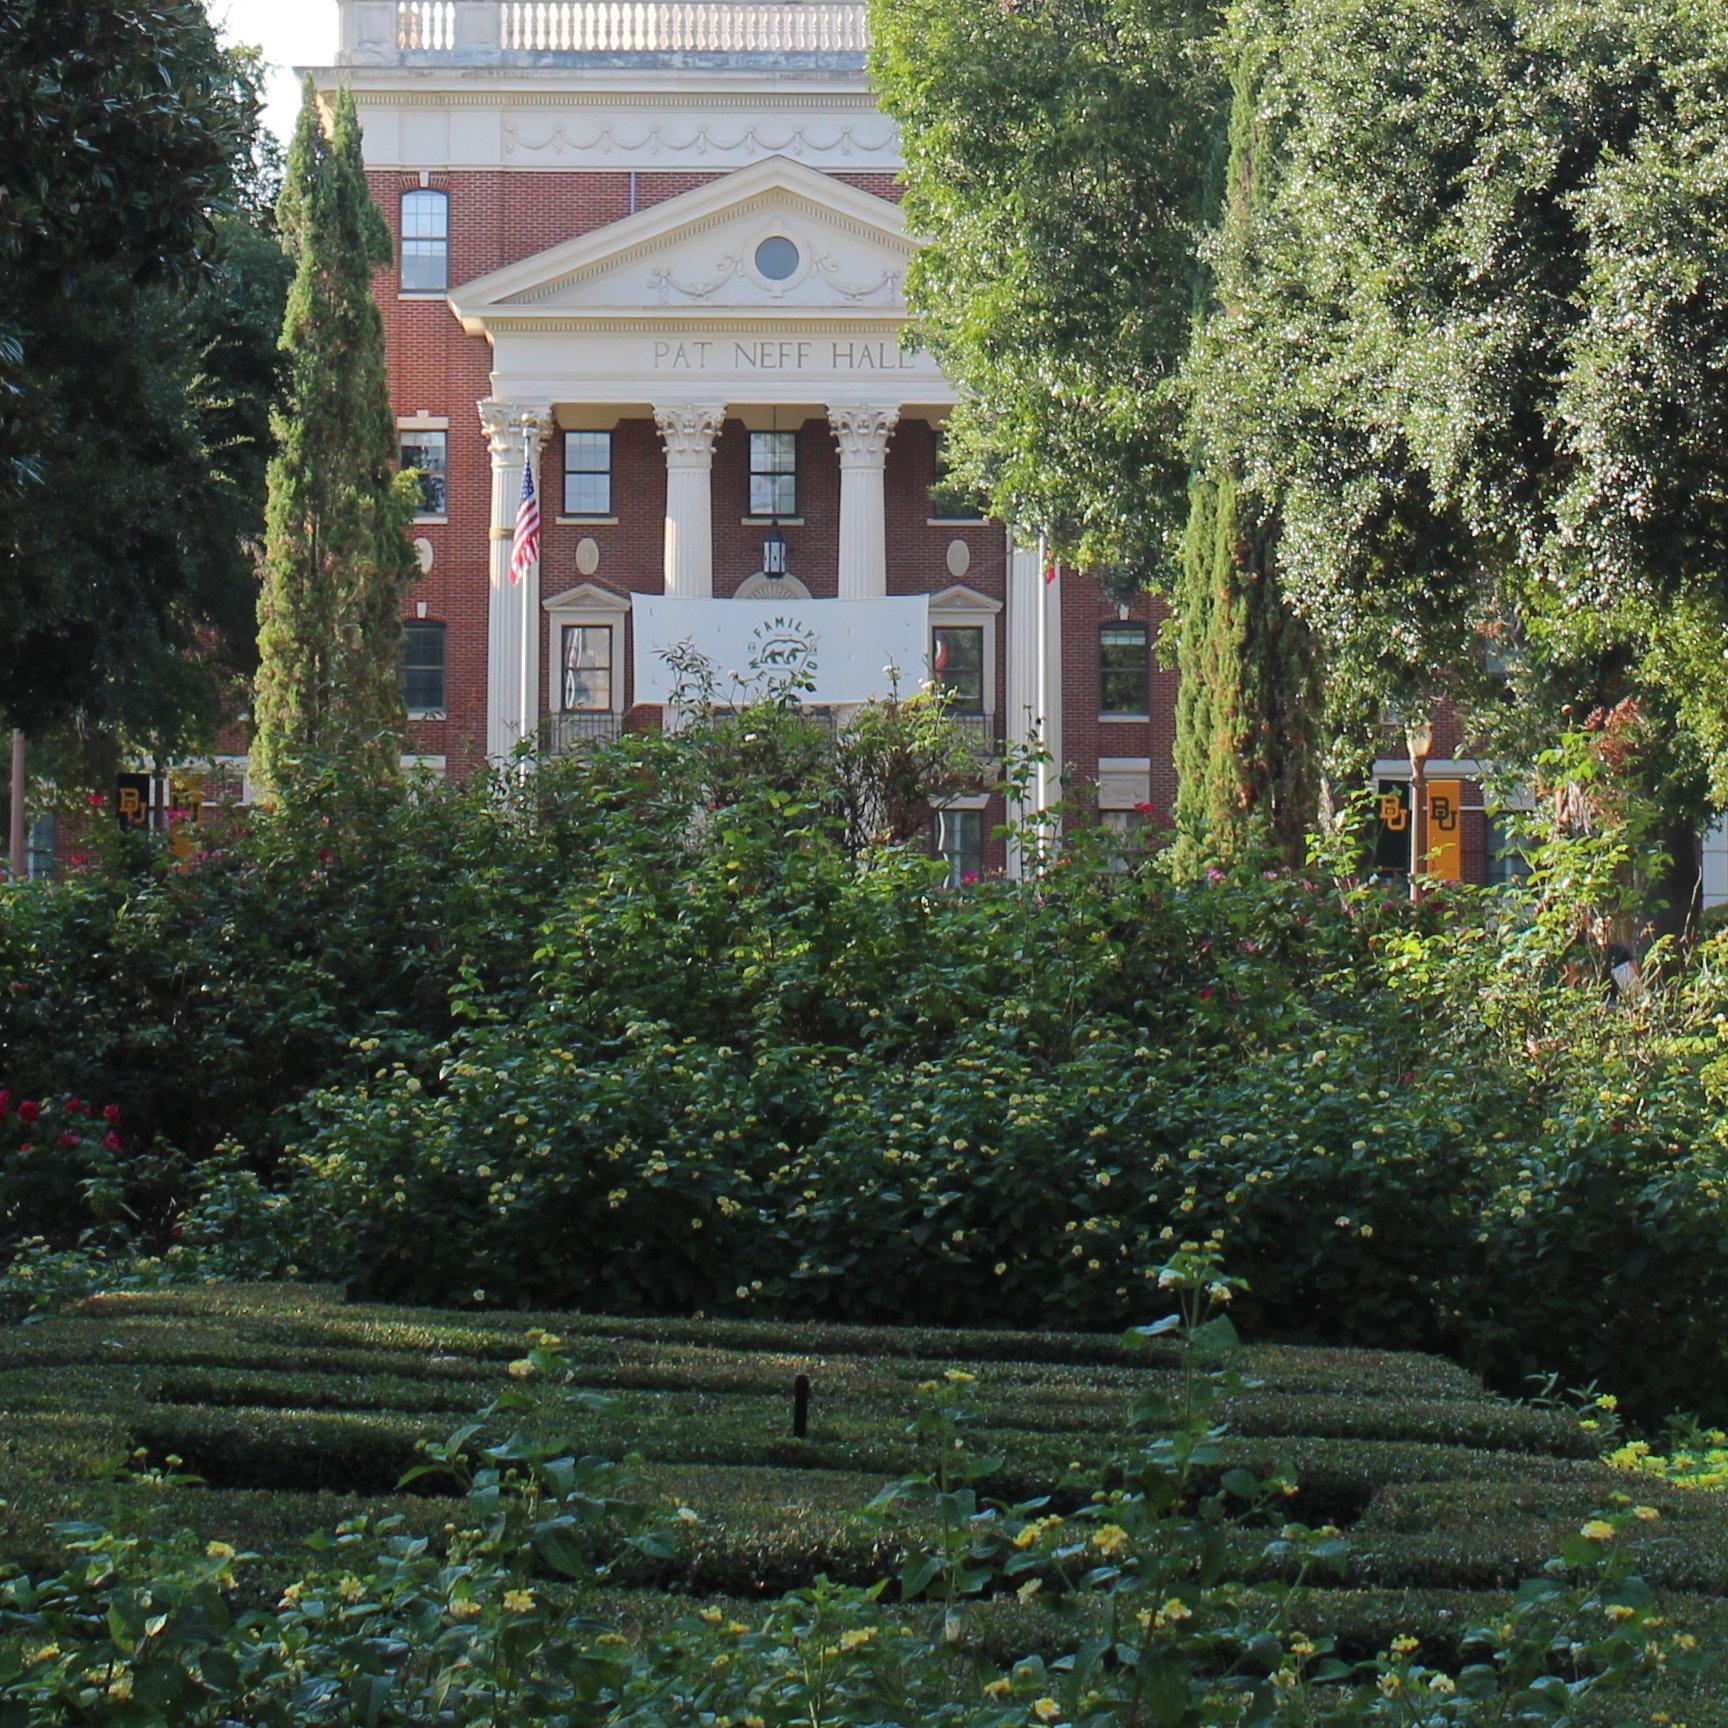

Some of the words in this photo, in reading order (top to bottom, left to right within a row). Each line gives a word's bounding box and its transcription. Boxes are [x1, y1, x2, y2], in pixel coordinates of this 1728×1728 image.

[653, 341, 714, 369] PAT
[734, 342, 812, 369] NEFF
[831, 342, 916, 370] HALL
[753, 616, 815, 640] FAMILY
[748, 657, 819, 690] WEEKD
[1379, 795, 1408, 832] BU
[1430, 796, 1457, 832] BU
